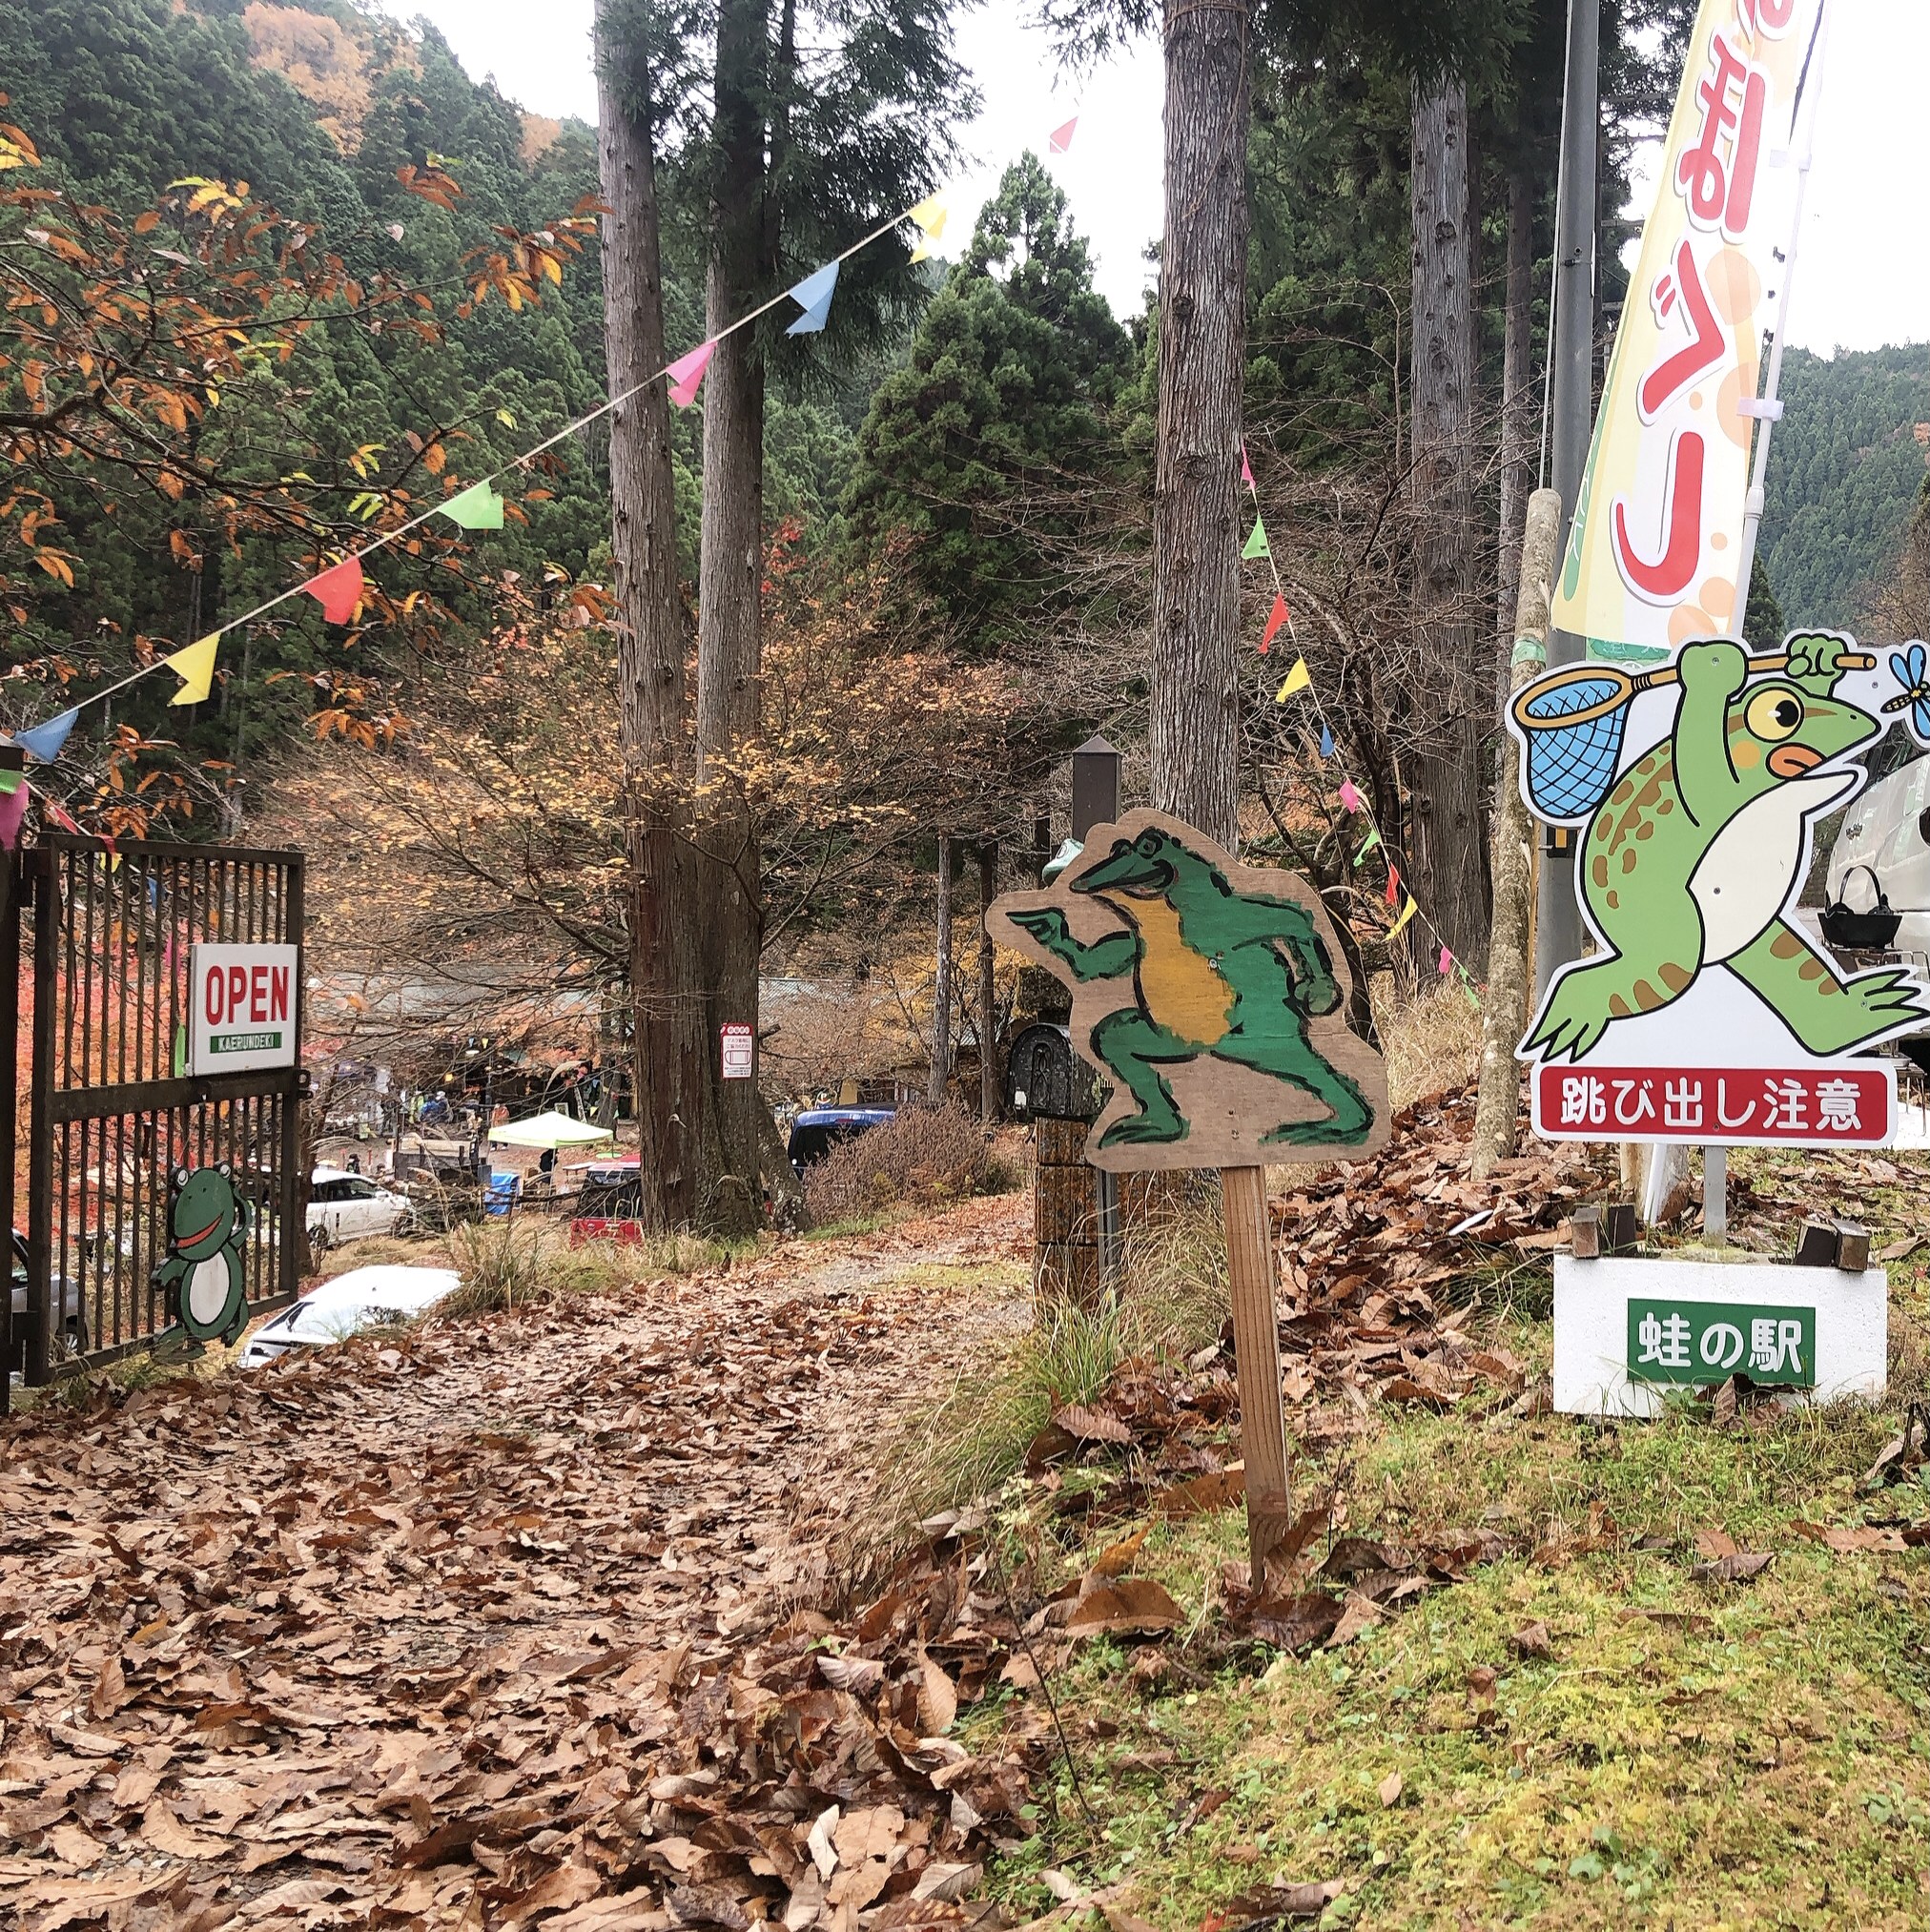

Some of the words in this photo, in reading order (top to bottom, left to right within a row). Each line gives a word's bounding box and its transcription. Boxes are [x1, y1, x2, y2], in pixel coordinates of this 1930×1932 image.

[205, 965, 290, 1026] OPEN
[1560, 1076, 1862, 1132] 跳び出し注意
[1637, 1311, 1803, 1374] 蛙の駅
